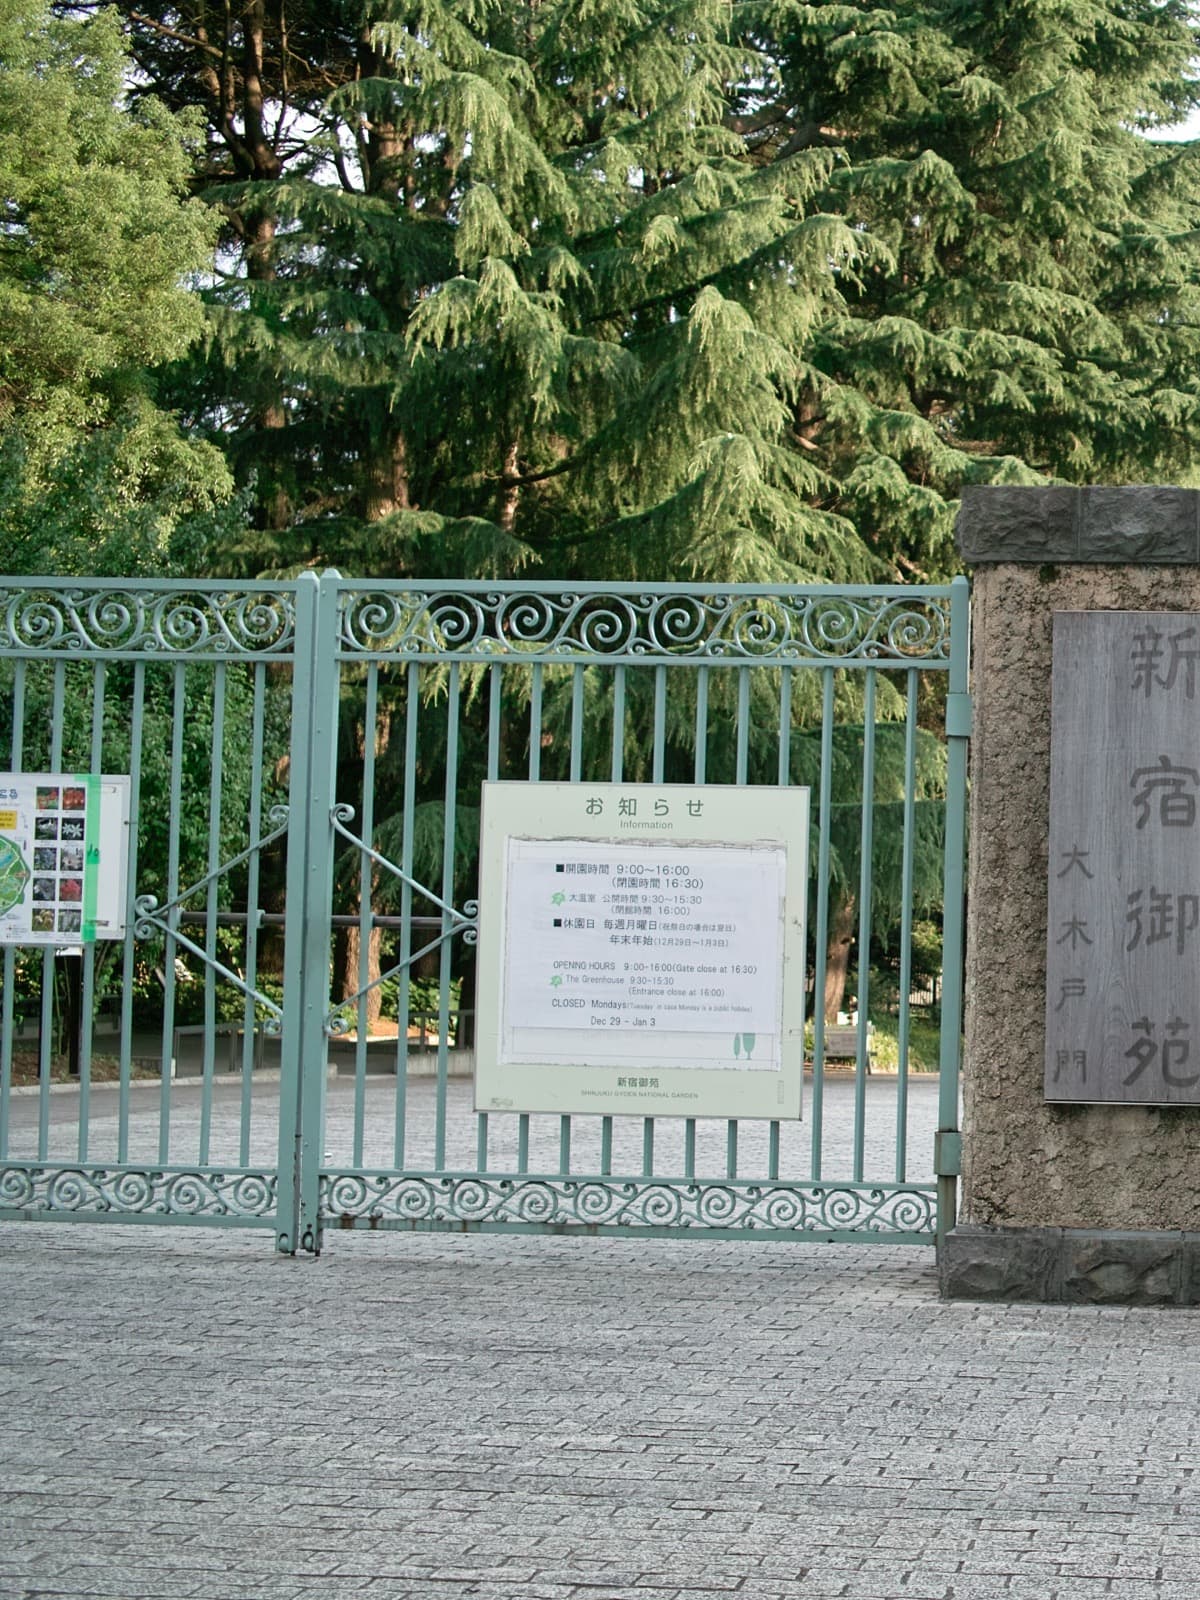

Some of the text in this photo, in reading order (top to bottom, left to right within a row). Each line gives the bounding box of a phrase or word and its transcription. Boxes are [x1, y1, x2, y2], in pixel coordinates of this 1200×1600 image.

[585, 797, 704, 817] お知らせ
[619, 820, 673, 829] Information
[565, 863, 609, 875] 開園時間
[665, 878, 704, 889] 16:30)
[568, 893, 596, 903] 大温室
[563, 918, 595, 929] 休園日
[553, 961, 587, 970] OPENING
[588, 961, 616, 970] HOURS
[696, 965, 718, 973] close
[1052, 843, 1095, 1085] 大木戸門
[566, 974, 580, 983] The
[582, 975, 625, 984] Greenhouse
[628, 987, 665, 996] (Entrance
[666, 988, 687, 996] close
[551, 999, 586, 1008] CLOSED
[590, 1016, 608, 1025] Dec
[609, 1016, 621, 1026] 29
[632, 1017, 647, 1026] Jan
[649, 1017, 656, 1026] 3
[617, 1076, 660, 1088] 新宿御苑
